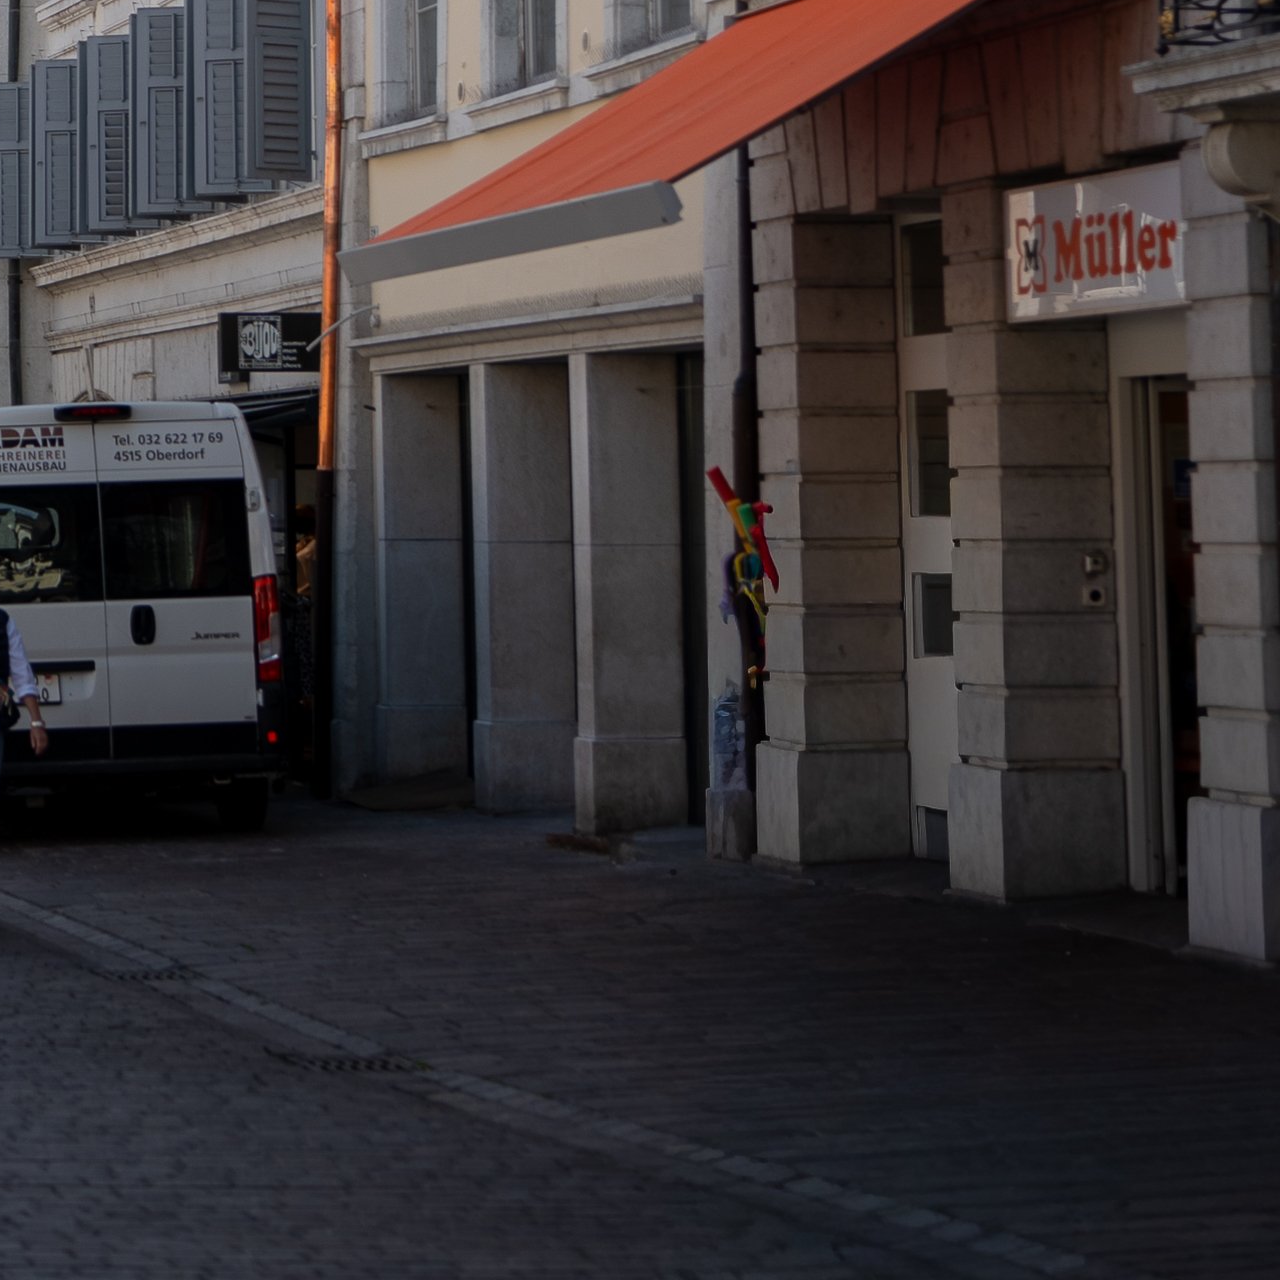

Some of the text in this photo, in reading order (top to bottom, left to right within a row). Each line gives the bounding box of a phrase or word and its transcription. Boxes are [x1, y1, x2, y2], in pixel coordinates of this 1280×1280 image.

[1053, 210, 1178, 284] Müller
[240, 321, 280, 360] BIJOU
[112, 431, 223, 447] Tel. 032 622 17 69
[114, 448, 205, 462] 4515 Oberdorf
